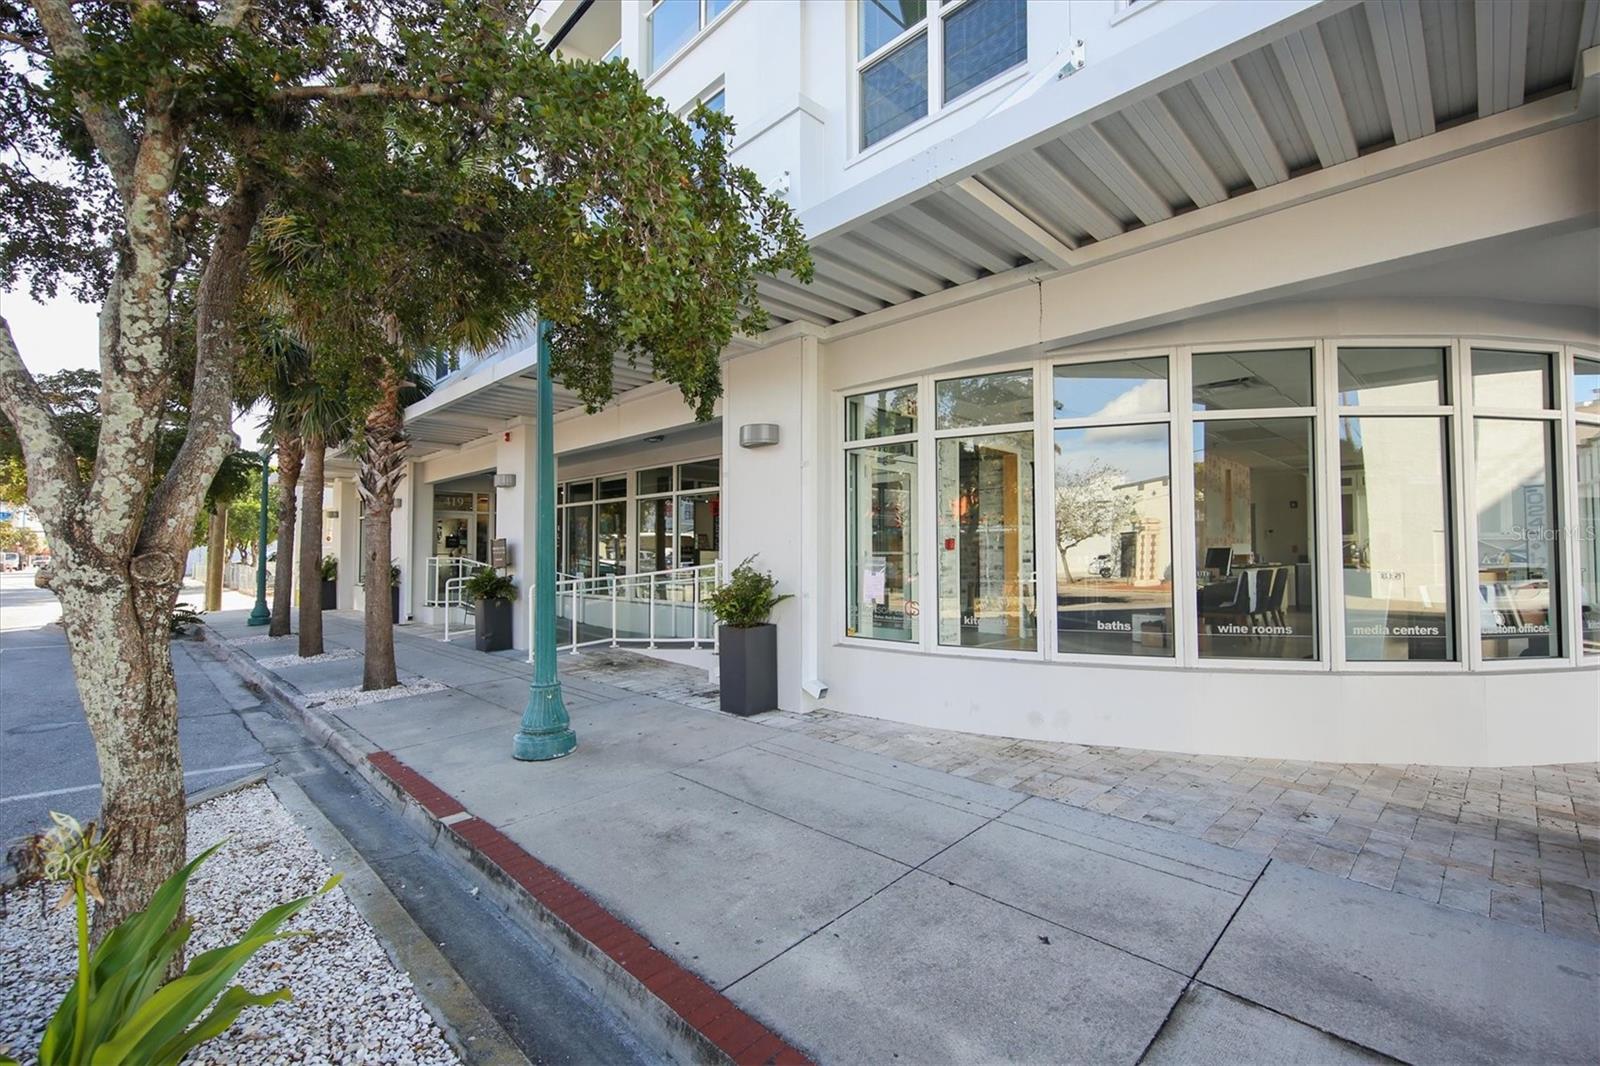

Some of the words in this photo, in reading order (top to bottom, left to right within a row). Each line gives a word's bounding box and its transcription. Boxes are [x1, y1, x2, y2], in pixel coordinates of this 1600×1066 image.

[1097, 620, 1131, 631] baths
[1218, 623, 1248, 634] wine
[1252, 625, 1293, 635] rooms
[1353, 623, 1390, 635] media
[1392, 625, 1439, 636] centers
[1518, 623, 1551, 633] offices
